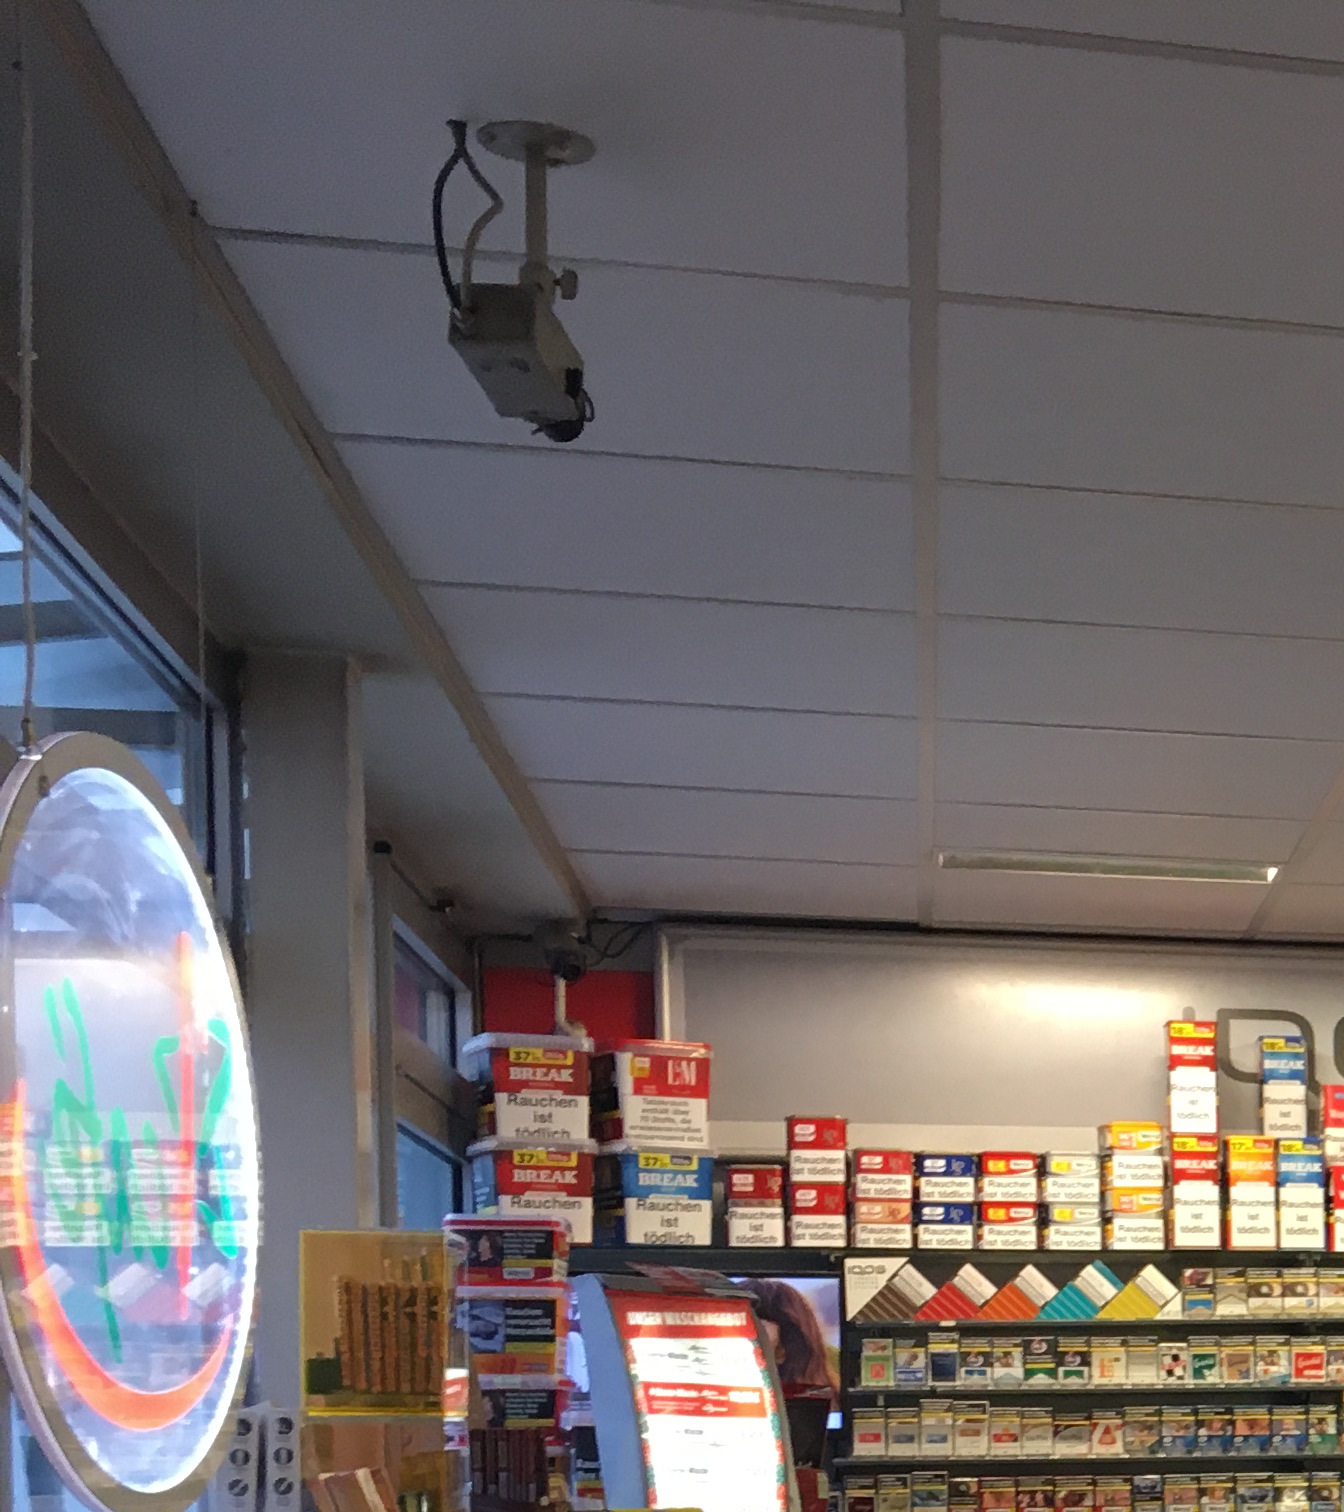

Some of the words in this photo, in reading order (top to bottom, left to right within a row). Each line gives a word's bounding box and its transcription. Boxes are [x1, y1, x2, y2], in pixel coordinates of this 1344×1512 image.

[1171, 1046, 1214, 1056] BREAK
[1263, 1059, 1305, 1070] BREAK
[509, 1067, 574, 1082] BREAK
[507, 1092, 578, 1109] Rauchen
[533, 1112, 553, 1124] ist
[514, 1127, 571, 1139] tödlich
[1174, 1159, 1217, 1169] BREAK
[1231, 1161, 1273, 1171] BREAK
[1280, 1162, 1322, 1172] BREAK
[512, 1169, 578, 1184] BREAK
[638, 1172, 699, 1187] BREAK
[510, 1195, 582, 1211] Rauchen
[636, 1199, 702, 1213] Rauchen
[729, 1210, 783, 1221] Rauchen
[660, 1216, 679, 1228] ist
[644, 1231, 695, 1246] tödlich
